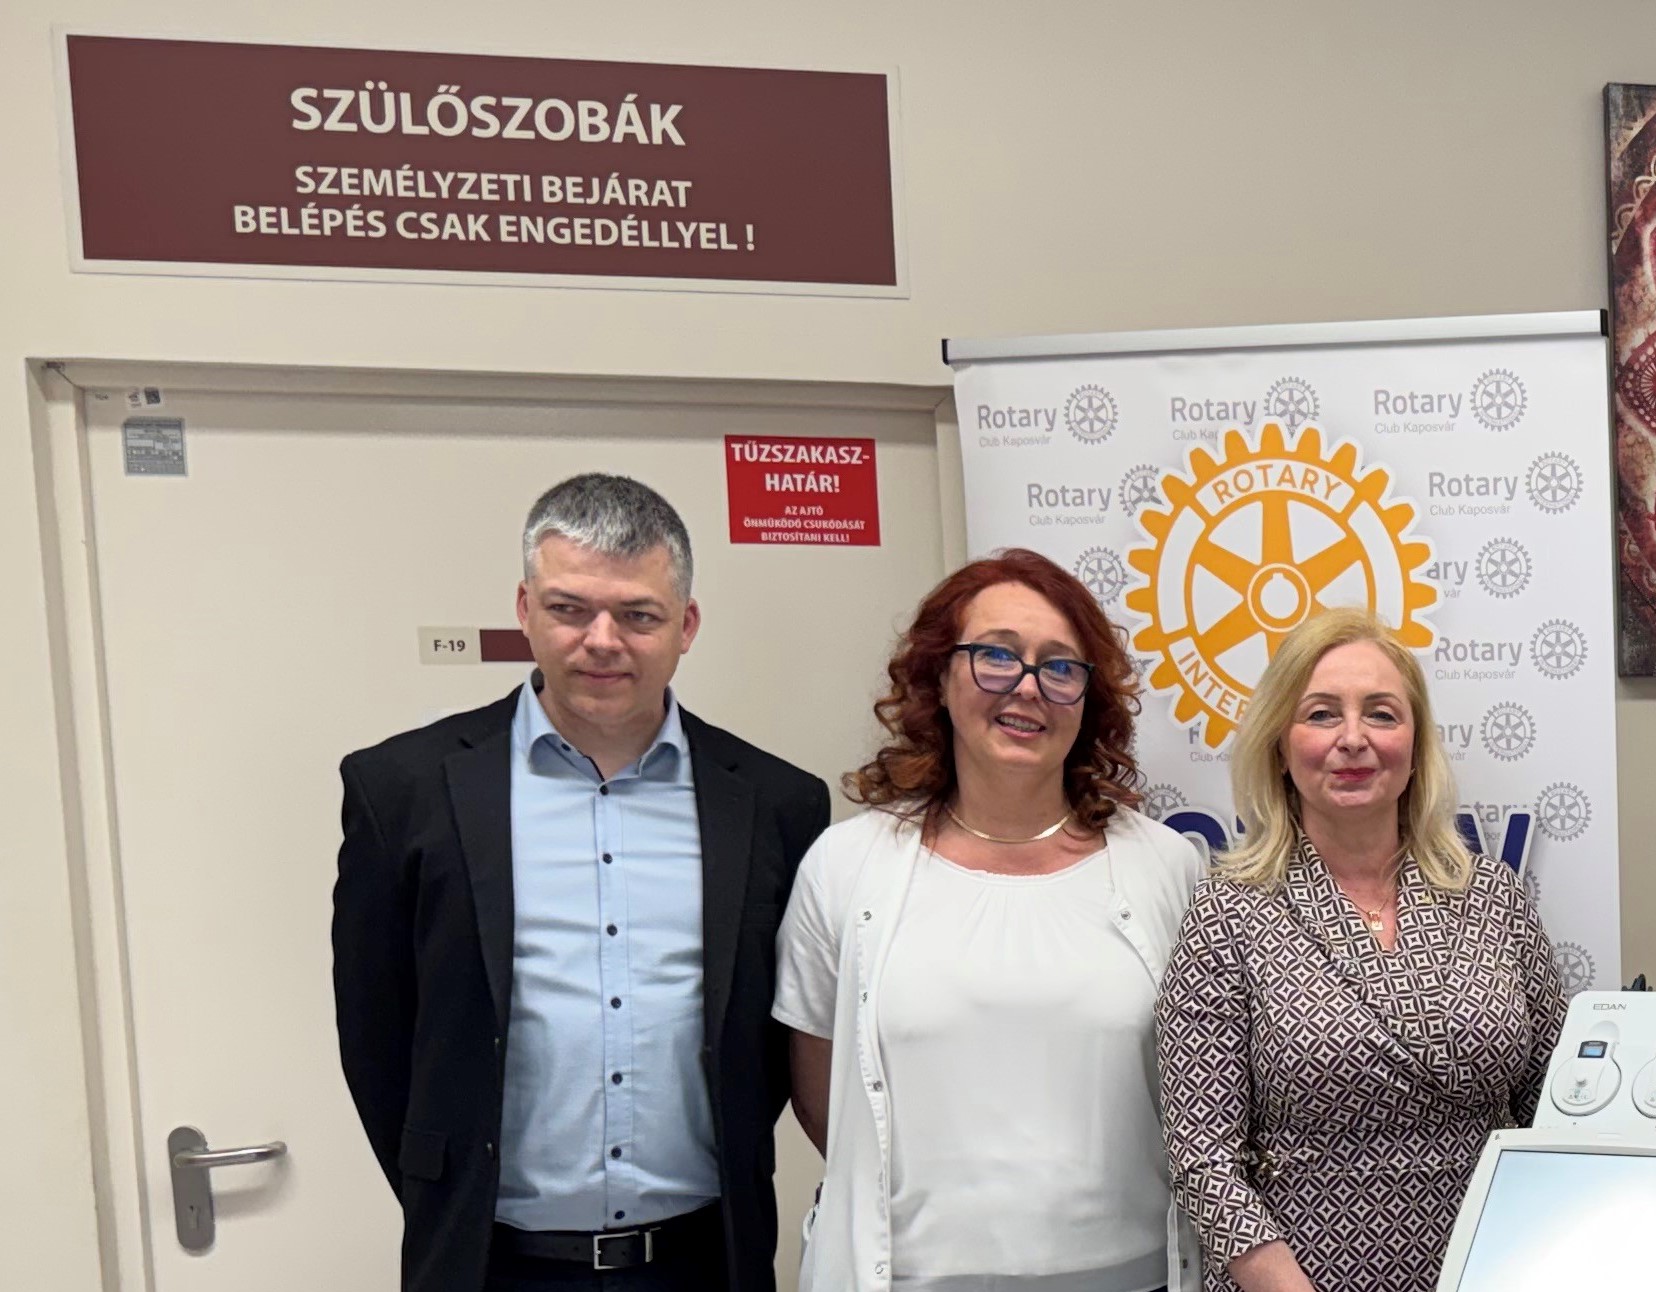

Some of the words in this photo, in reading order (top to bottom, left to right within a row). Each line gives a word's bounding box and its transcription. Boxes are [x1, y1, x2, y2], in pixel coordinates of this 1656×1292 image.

[290, 80, 686, 146] SZÜLŐSZOBÁK
[295, 164, 532, 202] SZEMÉLYZETI
[541, 172, 692, 208] BEJÁRAT
[233, 202, 387, 239] BELÉPÉS
[396, 210, 491, 242] CSAK
[499, 214, 738, 251] ENGEDÉLLYEL
[745, 224, 755, 251] !
[1170, 397, 1257, 423] Rotary
[1374, 389, 1463, 418] Rotary
[977, 403, 1058, 432] Rotary
[1374, 422, 1400, 434] Club
[1403, 421, 1455, 435] Kaposvár
[978, 435, 1001, 448] Club
[1002, 433, 1053, 448] Kaposvár
[1172, 429, 1198, 441] Club
[731, 440, 870, 465] TŰZSZAKASZ-
[764, 471, 840, 493] HATÁR!
[1211, 463, 1342, 505] ROTARY
[1428, 472, 1518, 501] Rotary
[1027, 483, 1112, 512] Rotary
[784, 506, 797, 516] AZ
[800, 505, 824, 516] AJTÓ
[1029, 514, 1053, 527] Club
[1054, 513, 1106, 528] Kaposvár
[1429, 504, 1455, 517] Club
[1458, 503, 1512, 518] Kaposvár
[823, 533, 850, 543] KELL!
[1426, 560, 1468, 586] ary
[433, 639, 466, 652] F-19
[1434, 636, 1523, 666] Rotary
[1435, 668, 1461, 681] Club
[1463, 667, 1516, 682] Kaposvár
[1436, 722, 1474, 749] ary
[1190, 751, 1214, 763] Club
